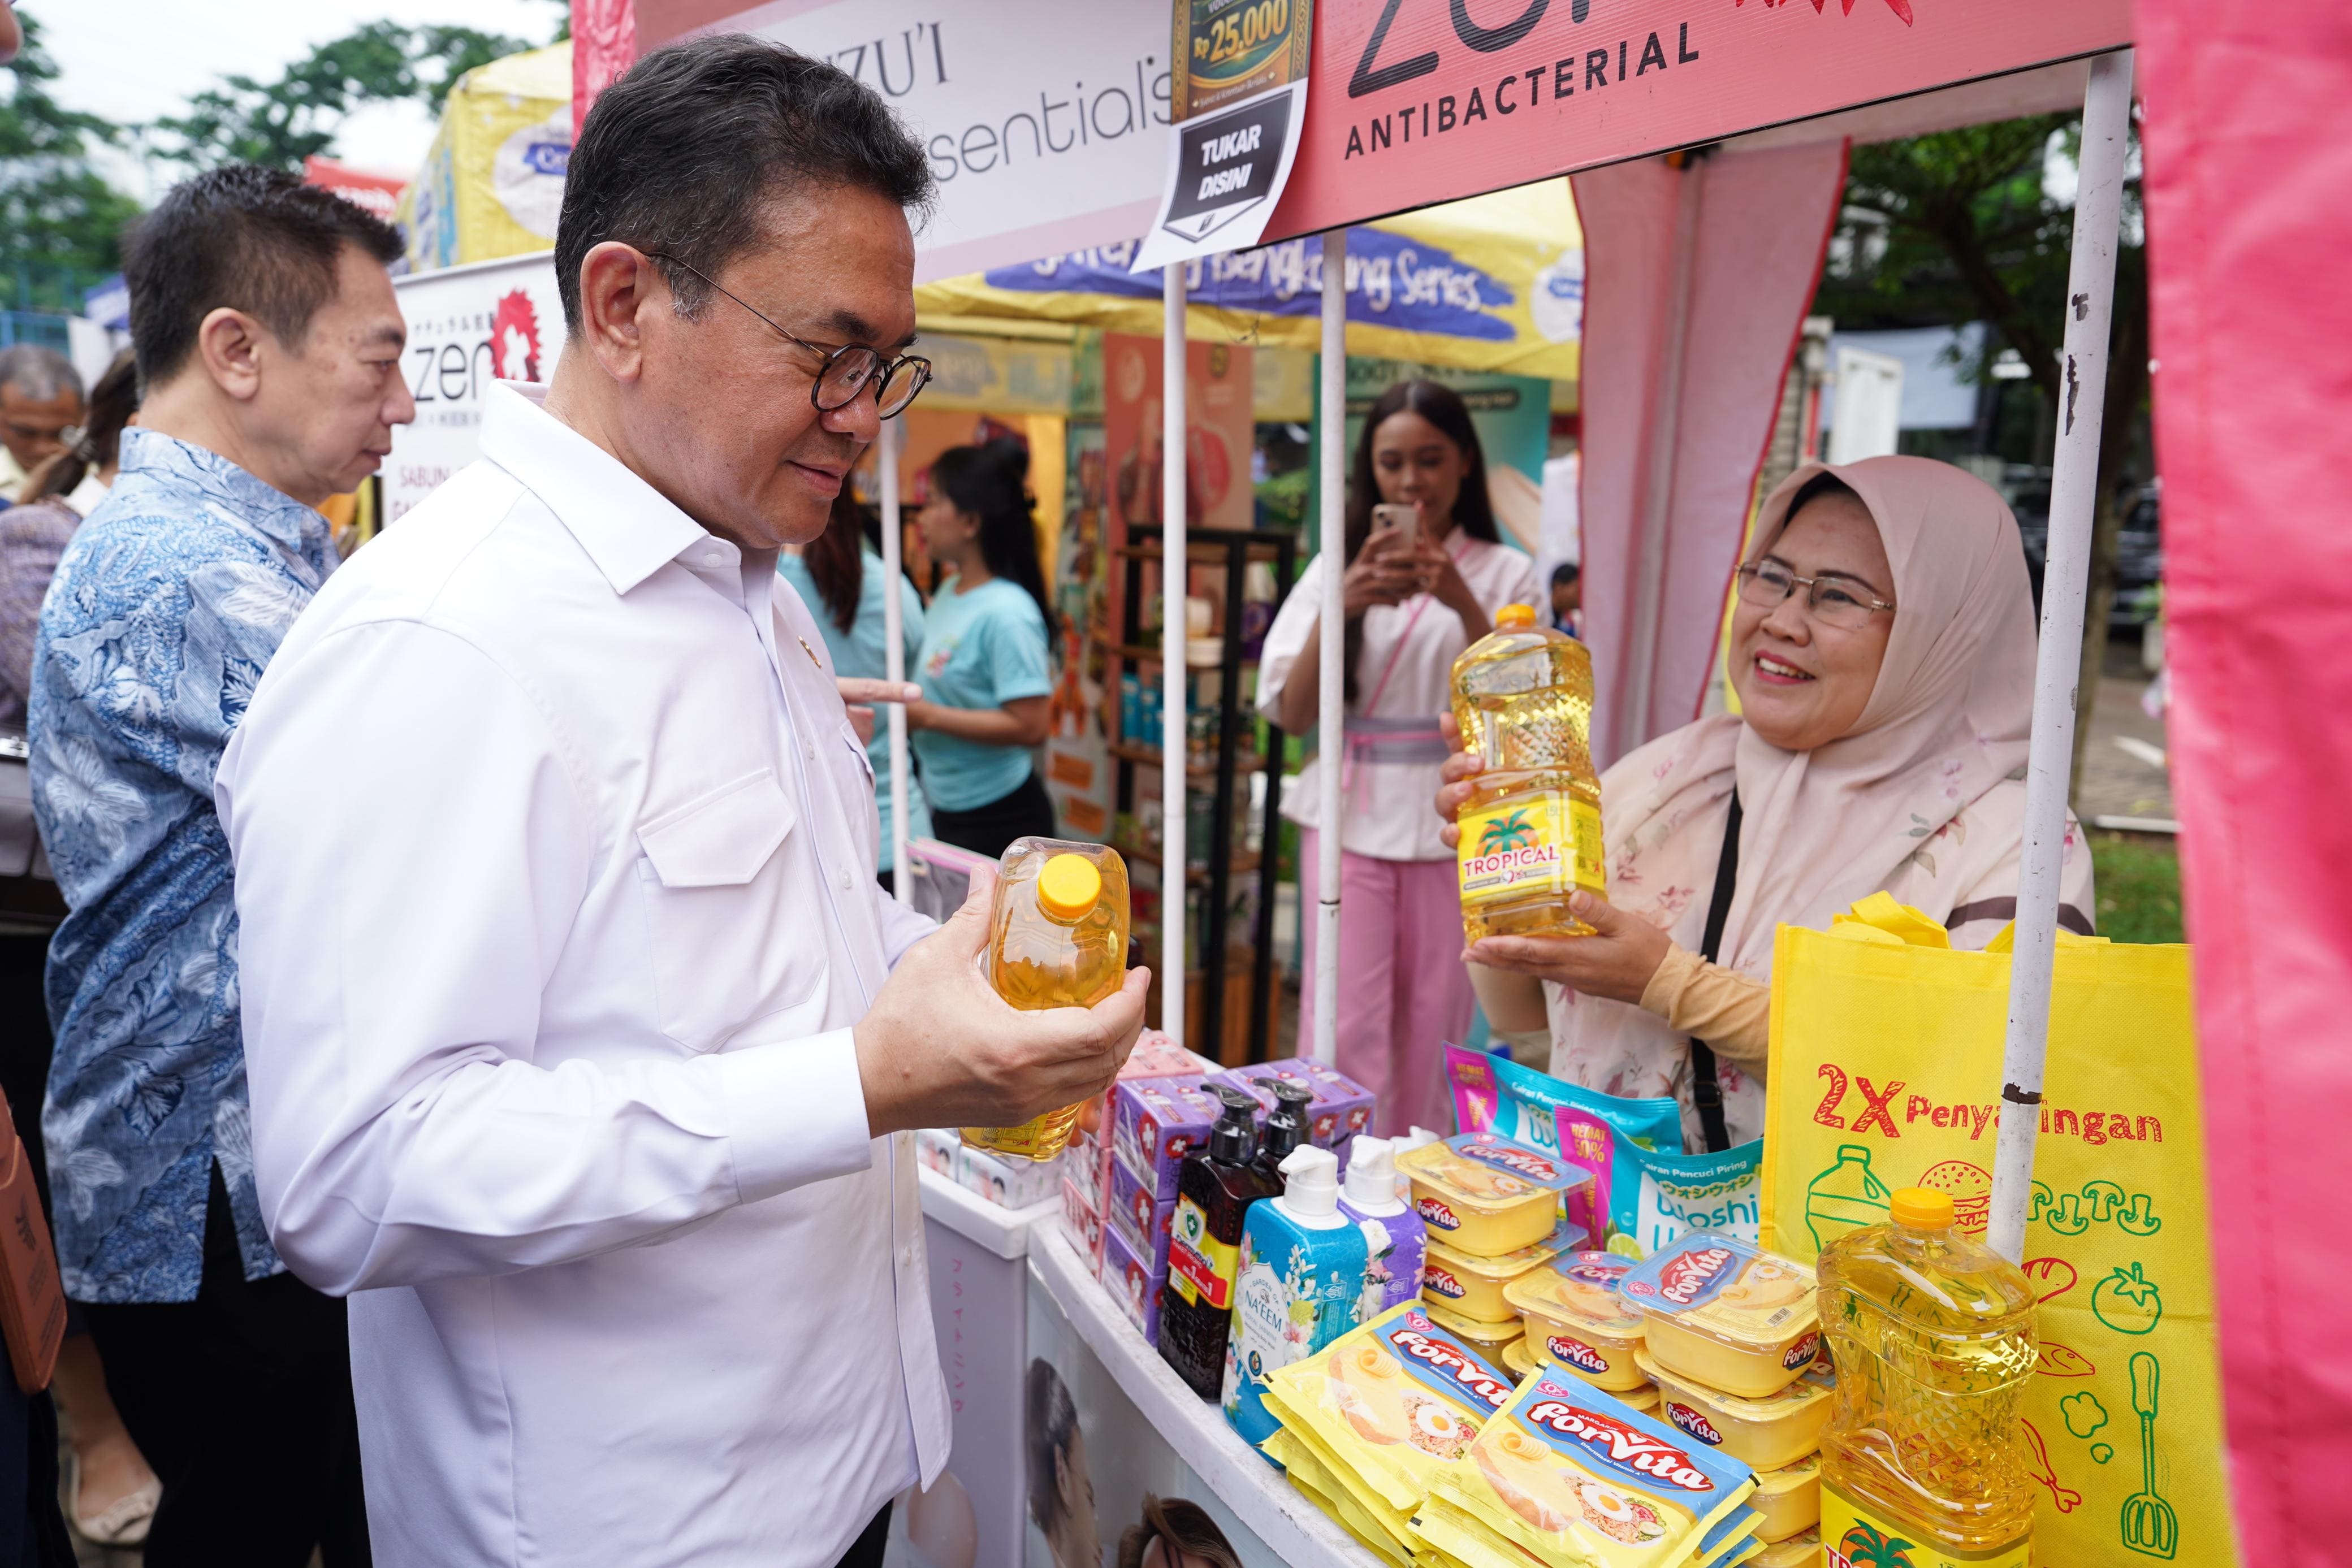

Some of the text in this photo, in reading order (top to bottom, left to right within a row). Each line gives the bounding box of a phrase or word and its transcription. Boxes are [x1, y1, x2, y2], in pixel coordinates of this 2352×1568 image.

[1194, 0, 1287, 62] Rp 25.000
[1344, 21, 1699, 161] ANTIBACTERIAL
[1201, 124, 1262, 166] TUKAR
[1197, 162, 1253, 201] DISINI
[1397, 248, 1481, 311] Series
[1464, 846, 1559, 876] TROPICAL
[1813, 1063, 2163, 1146] 2X Penyingan
[1571, 1123, 1606, 1142] HEMAT
[1575, 1140, 1605, 1163] 50%
[1640, 1159, 1747, 1178] airan Pencuci Piring
[1252, 1278, 1279, 1305] GARDEN OF
[1245, 1290, 1282, 1332] NA'EEM
[1434, 1344, 1471, 1362] MARGARIN
[1456, 1382, 1474, 1397] Vitamin
[1577, 1414, 1619, 1431] MARGARIN
[1580, 1441, 1612, 1465] Difortifikasi
[1613, 1461, 1635, 1475] Vitamin
[1450, 1471, 1463, 1484] 200g
